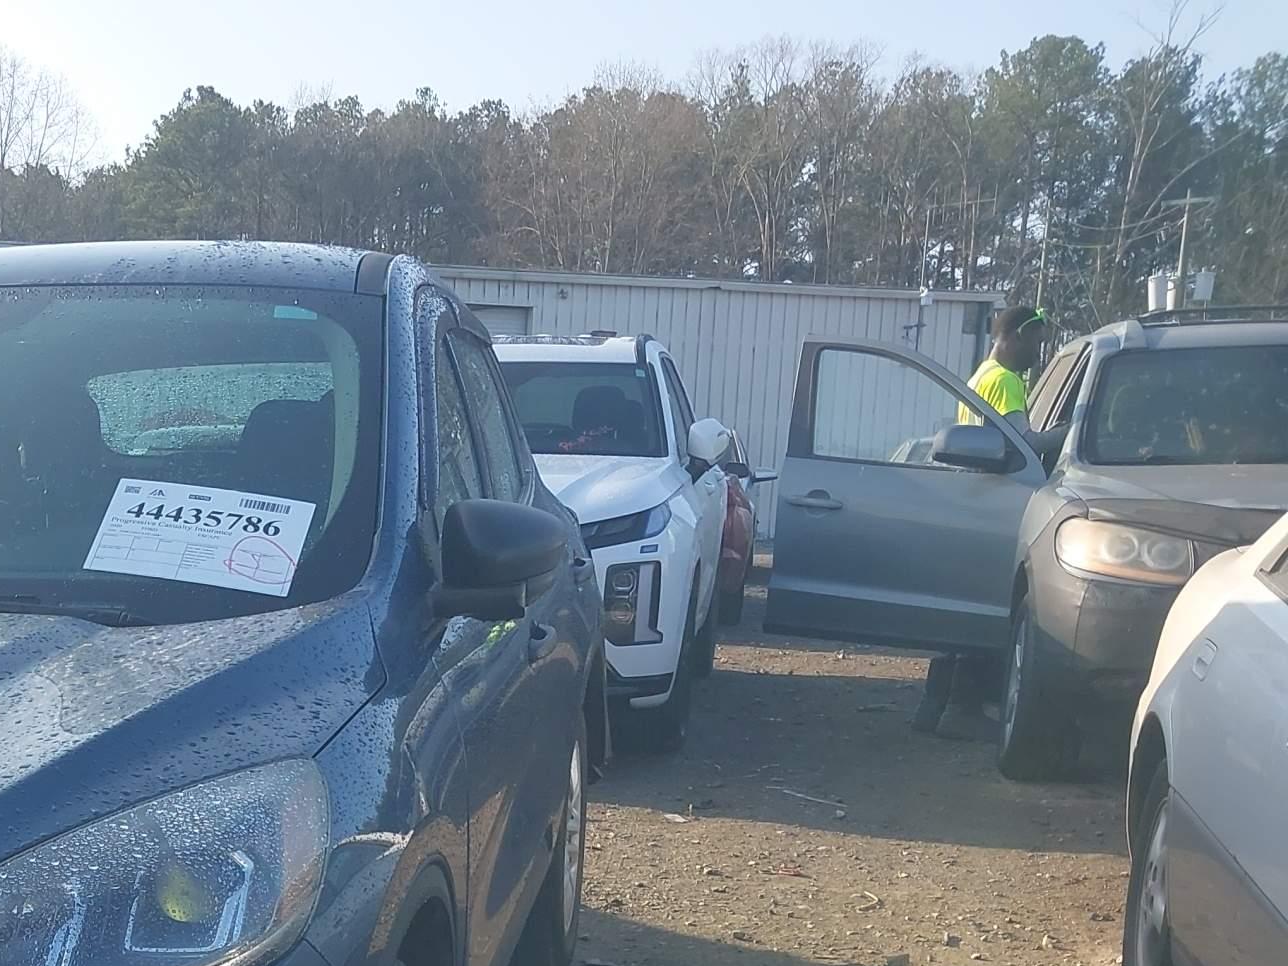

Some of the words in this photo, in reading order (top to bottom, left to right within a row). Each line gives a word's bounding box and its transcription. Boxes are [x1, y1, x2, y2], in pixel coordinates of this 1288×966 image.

[111, 516, 157, 526] Progressive
[158, 521, 192, 531] Casualty
[195, 526, 233, 536] Insurance
[126, 501, 284, 537] 44435786
